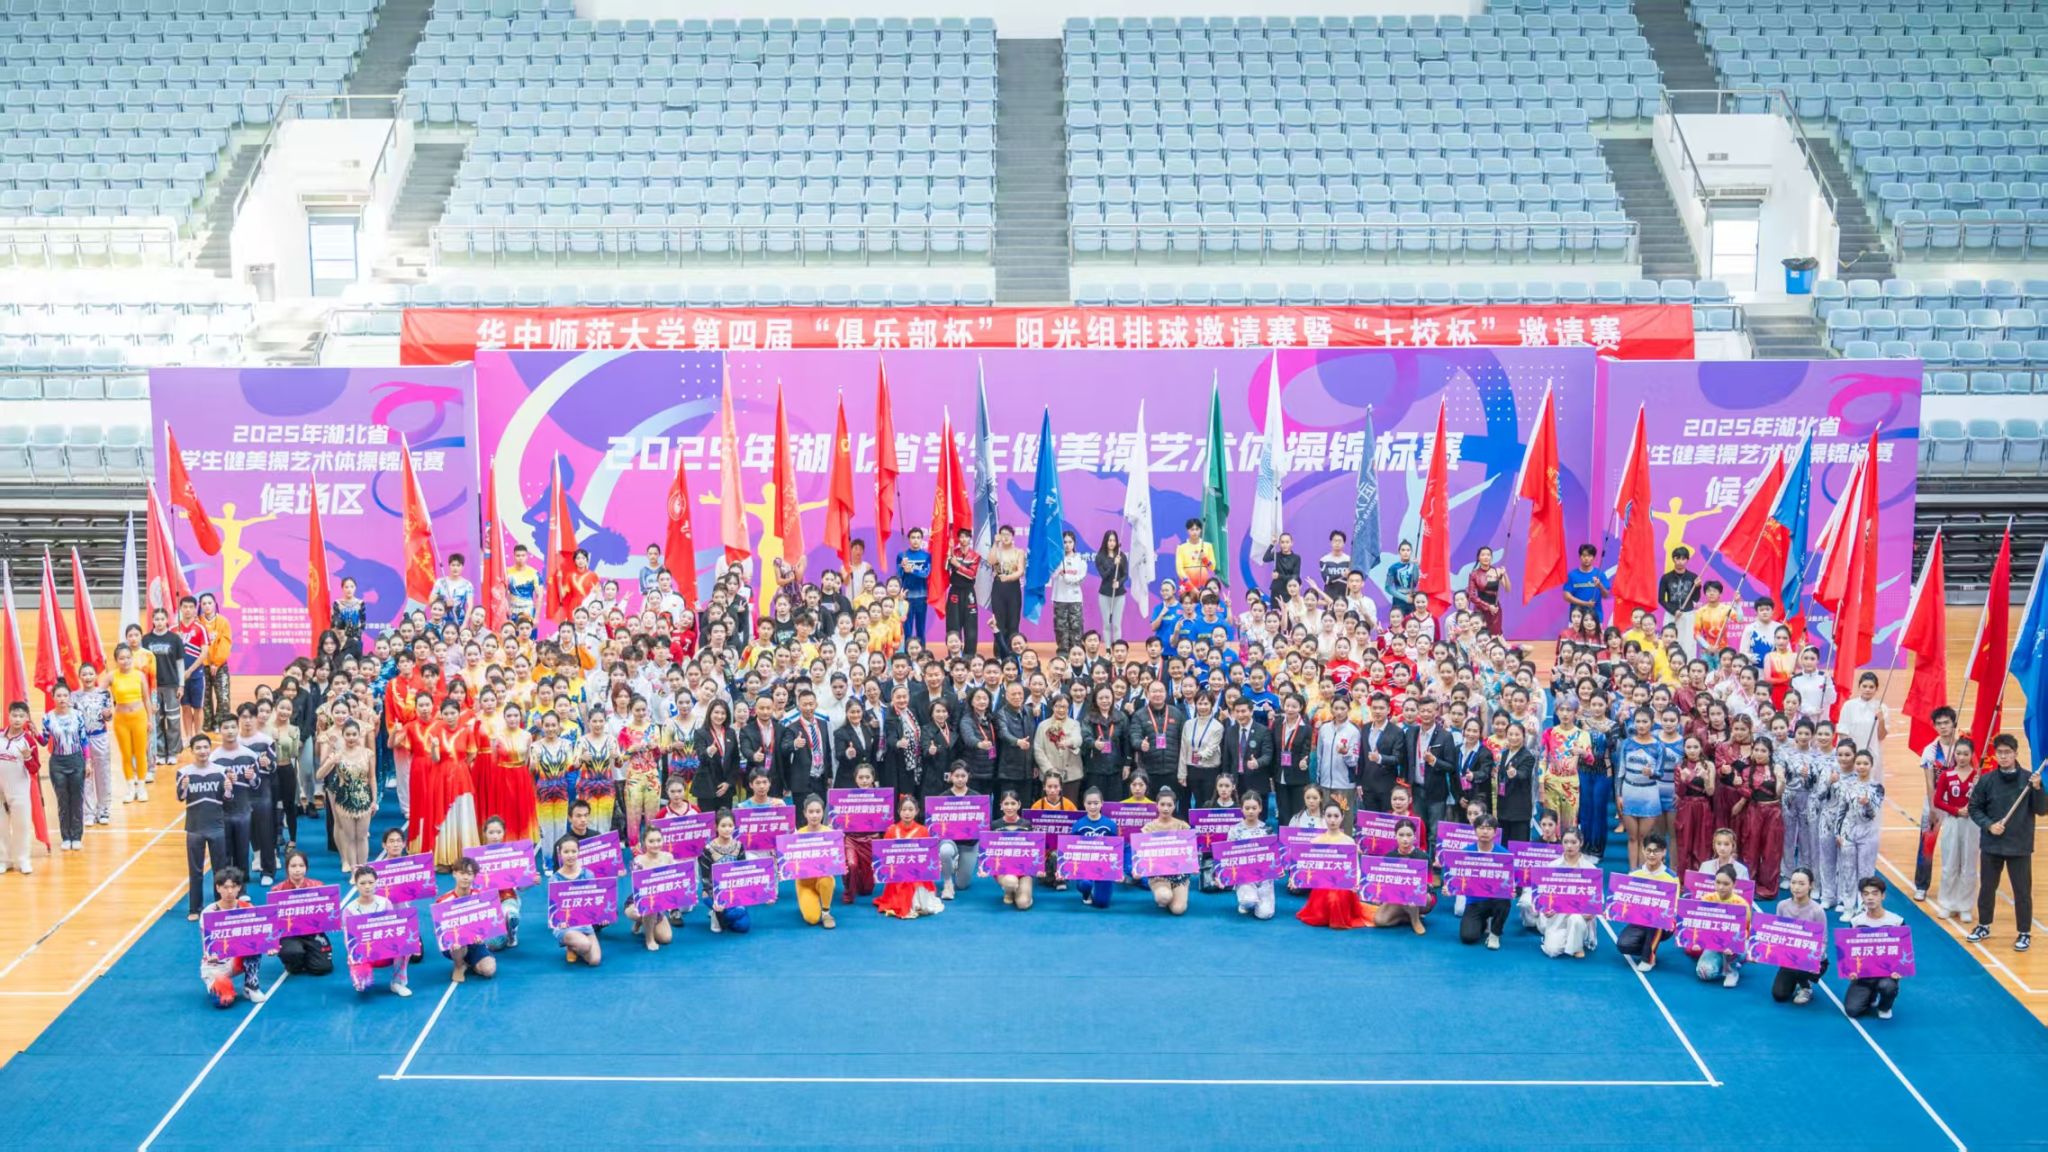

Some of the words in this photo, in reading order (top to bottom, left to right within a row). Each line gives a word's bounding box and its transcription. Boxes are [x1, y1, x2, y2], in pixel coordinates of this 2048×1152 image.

[232, 424, 389, 445] 2025年湖北省
[1683, 416, 1841, 438] 2025年湖北省
[260, 482, 366, 515] 候场区
[188, 781, 220, 793] WHXY
[885, 854, 927, 865] 武汉大学
[561, 895, 605, 909] 江汉大学
[361, 925, 406, 942] 三峡大学
[1850, 945, 1899, 957] 武汉学院
